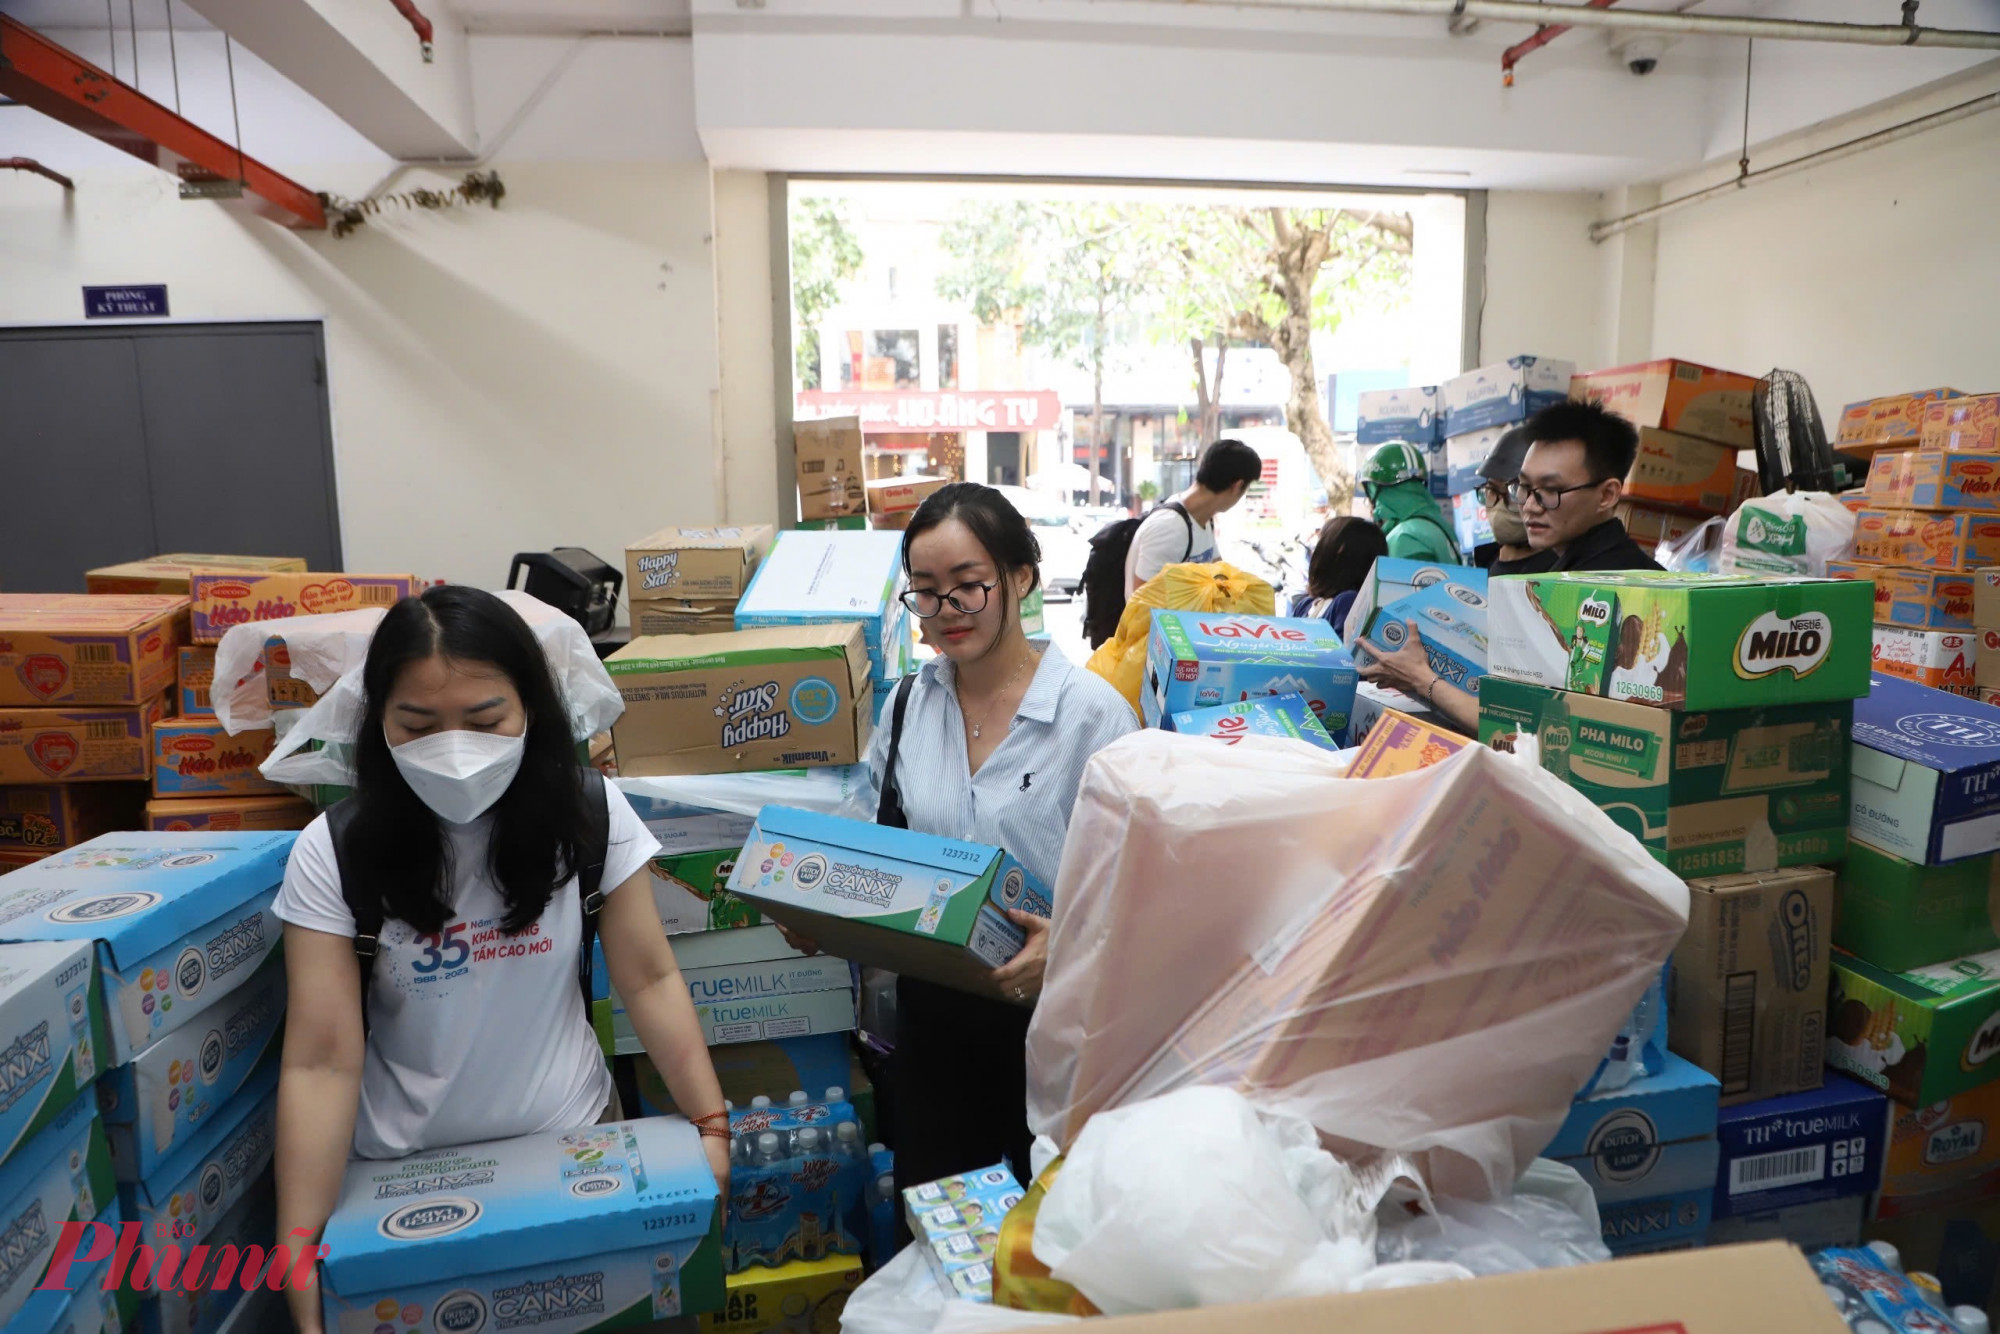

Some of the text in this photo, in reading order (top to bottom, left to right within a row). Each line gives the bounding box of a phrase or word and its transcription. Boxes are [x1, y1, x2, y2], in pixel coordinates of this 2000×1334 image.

[105, 289, 147, 301] PHÒNG
[117, 301, 156, 314] THUẬT
[1003, 398, 1038, 426] TV
[638, 552, 678, 572] Happy
[642, 569, 673, 590] Star
[209, 596, 295, 627] Hảo Hảo
[1582, 603, 1606, 620] MILO
[1199, 622, 1306, 641] laVie
[1790, 618, 1821, 631] Nestlé
[1748, 629, 1821, 661] MILO
[1430, 658, 1466, 684] NXI
[620, 689, 707, 702] NUTRITIOUS MILK SWEETEN
[727, 681, 779, 720] Star
[1616, 681, 1663, 701] 12630969
[721, 710, 790, 749] Happy
[1545, 732, 1570, 747] MILO
[1580, 726, 1645, 751] PHA MILO
[179, 752, 217, 776] Hảo
[781, 751, 829, 764] Vinamilk
[1855, 803, 1900, 828] CÓ ĐƯỜNG
[24, 829, 46, 846] 02
[942, 848, 981, 863] 1237312
[1676, 846, 1744, 872] 12561852
[800, 872, 815, 881] LADY
[801, 866, 820, 876] DUTCH
[833, 862, 865, 875] NGUỒN
[877, 871, 902, 884] SUNG
[827, 871, 898, 899] CANXI
[472, 923, 540, 946] KHÁT ỌNG
[1780, 890, 1811, 991] OREO
[208, 924, 265, 970] CANXI
[412, 922, 470, 973] 35
[498, 944, 526, 959] CAO
[529, 938, 553, 955] MỚI
[54, 958, 88, 988] 1237312
[413, 974, 437, 985] 1988
[445, 967, 468, 980] 2023
[688, 973, 787, 998] rueMILK
[713, 1002, 789, 1023] trueMILK
[0, 1036, 51, 1094] ANXI
[1744, 1112, 1861, 1145] TH trueMILK
[1604, 1134, 1639, 1148] DUTCH
[1931, 1129, 1976, 1154] ROYAL
[1613, 1154, 1638, 1166] LADY
[378, 1170, 494, 1195] CANXI
[405, 1213, 458, 1229] DUTCH
[411, 1207, 452, 1220] LADY
[642, 1213, 696, 1231] 1237312
[1601, 1210, 1671, 1238] ANXI
[0, 1211, 47, 1277] ANXI
[493, 1271, 604, 1299] NGUỒN BỔ SUNG
[493, 1282, 603, 1320] CANXI
[444, 1306, 476, 1320] DUTCH
[448, 1315, 473, 1327] LADY
